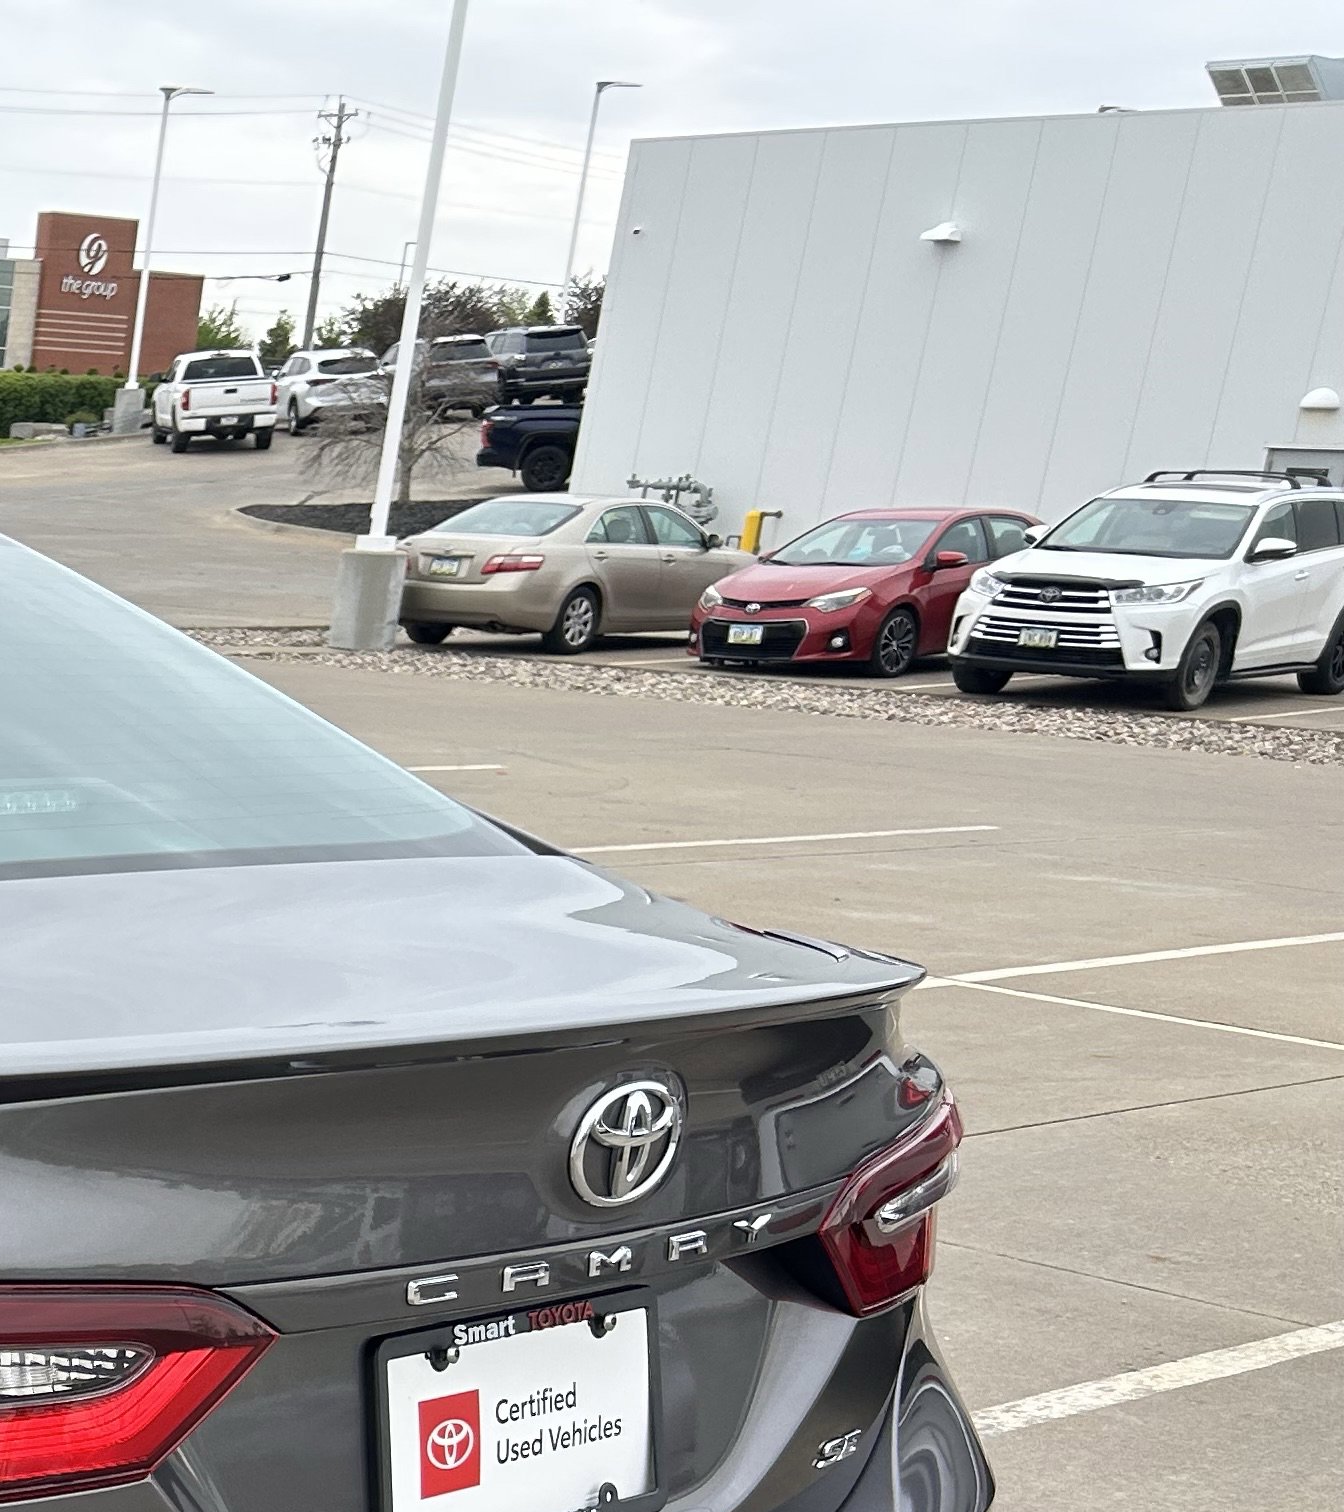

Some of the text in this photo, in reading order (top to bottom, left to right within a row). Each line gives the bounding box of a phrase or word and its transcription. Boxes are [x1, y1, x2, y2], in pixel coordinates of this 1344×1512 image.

[61, 276, 118, 300] the group
[407, 1213, 771, 1305] CAMRY
[453, 1300, 595, 1346] Smart TOYOTA
[495, 1381, 577, 1425] Certified
[496, 1414, 622, 1465] Used Vehicles
[812, 1428, 861, 1469] SE
